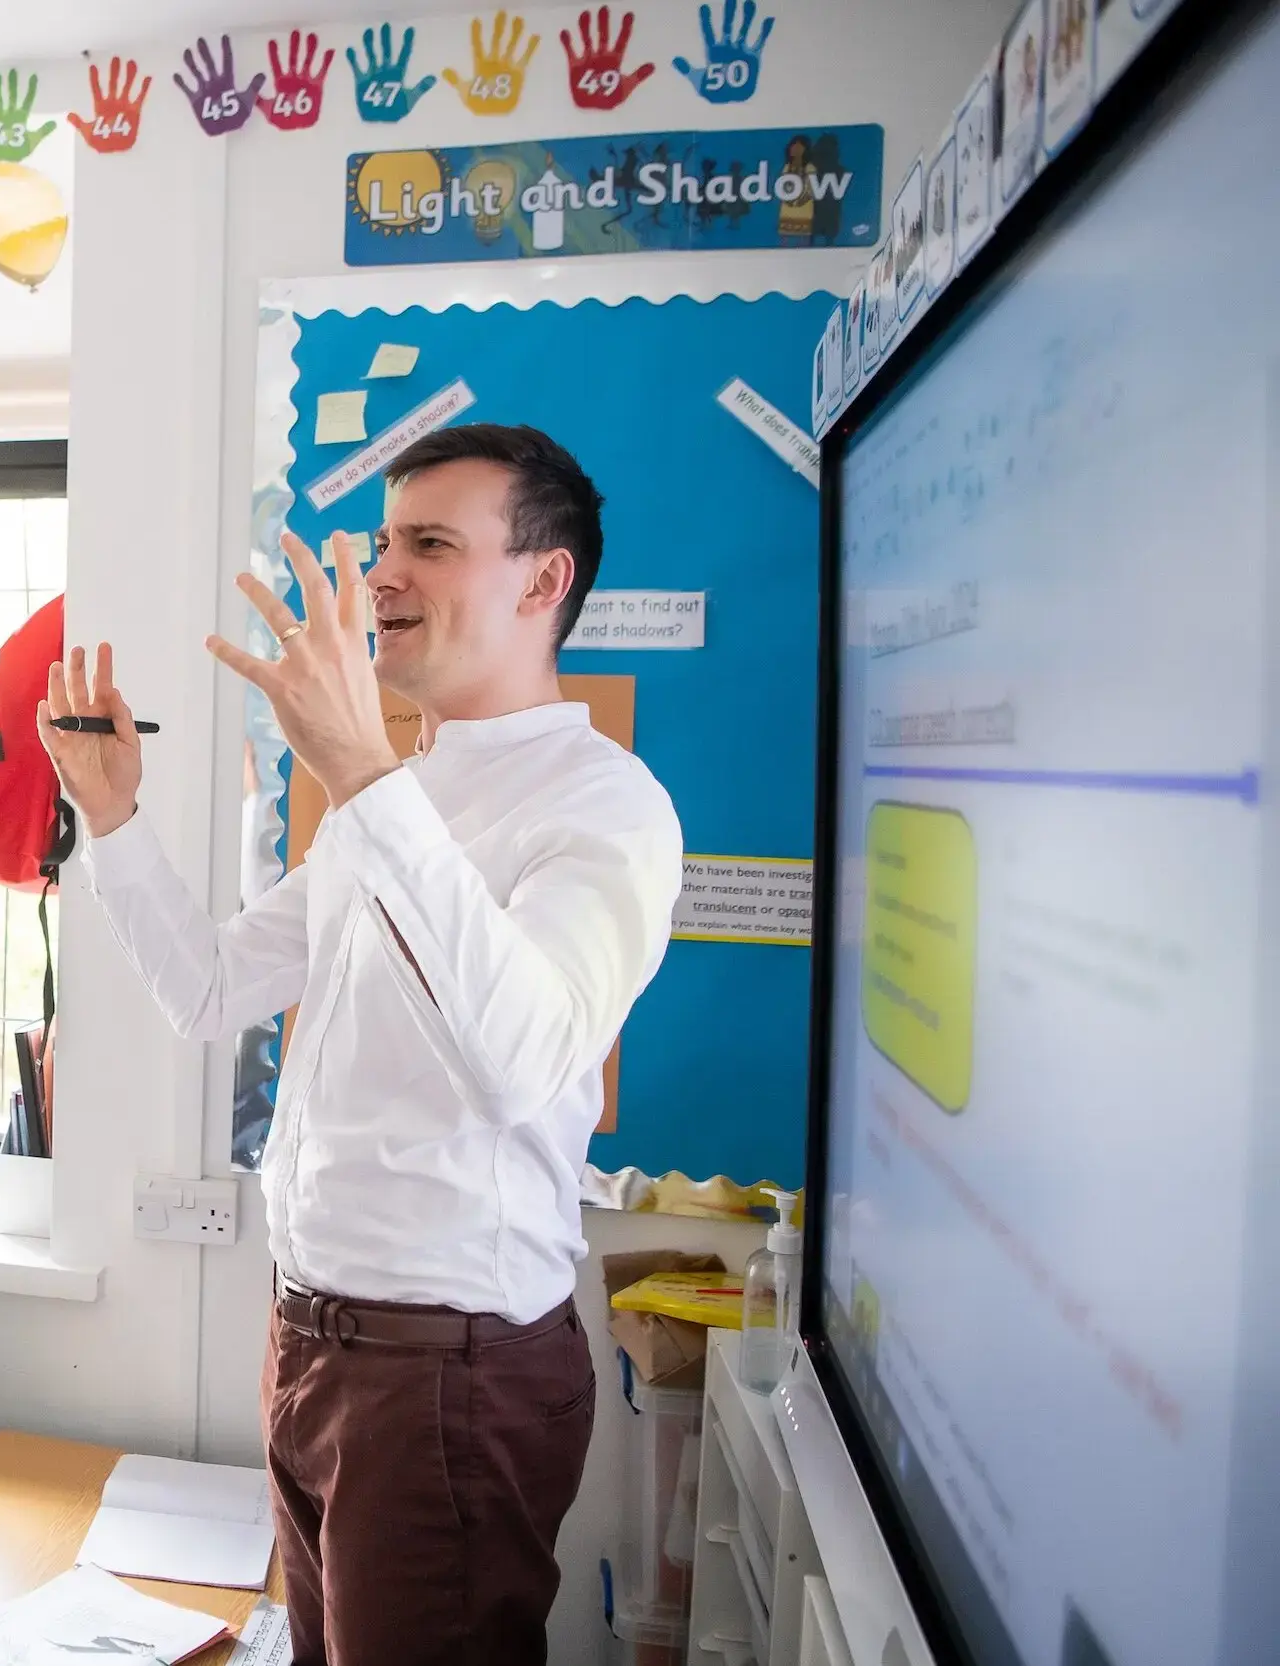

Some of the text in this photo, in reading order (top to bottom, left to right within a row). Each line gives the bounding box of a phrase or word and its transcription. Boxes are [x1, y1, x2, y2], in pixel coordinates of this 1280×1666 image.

[470, 73, 512, 102] 48
[577, 68, 620, 98] 49
[706, 60, 749, 91] 50
[201, 89, 240, 121] 45
[273, 87, 314, 118] 46
[363, 80, 402, 109] 47
[92, 111, 131, 139] 44
[368, 157, 854, 235] Light and Shadow
[734, 388, 765, 416] What
[764, 413, 790, 438] does
[320, 392, 460, 498] How do you make a shadow?
[580, 598, 699, 613] want to find out
[582, 623, 608, 637] and
[612, 623, 683, 637] shadows?
[683, 864, 704, 875] We
[707, 865, 733, 877] have
[737, 867, 765, 878] been
[681, 882, 707, 892] ther
[711, 884, 763, 897] materials
[766, 887, 787, 898] are
[693, 902, 757, 915] translucent
[760, 905, 774, 916] or
[678, 920, 695, 929] you
[697, 920, 727, 930] explain
[730, 921, 752, 931] what
[754, 923, 778, 933] these
[780, 924, 796, 936] key
